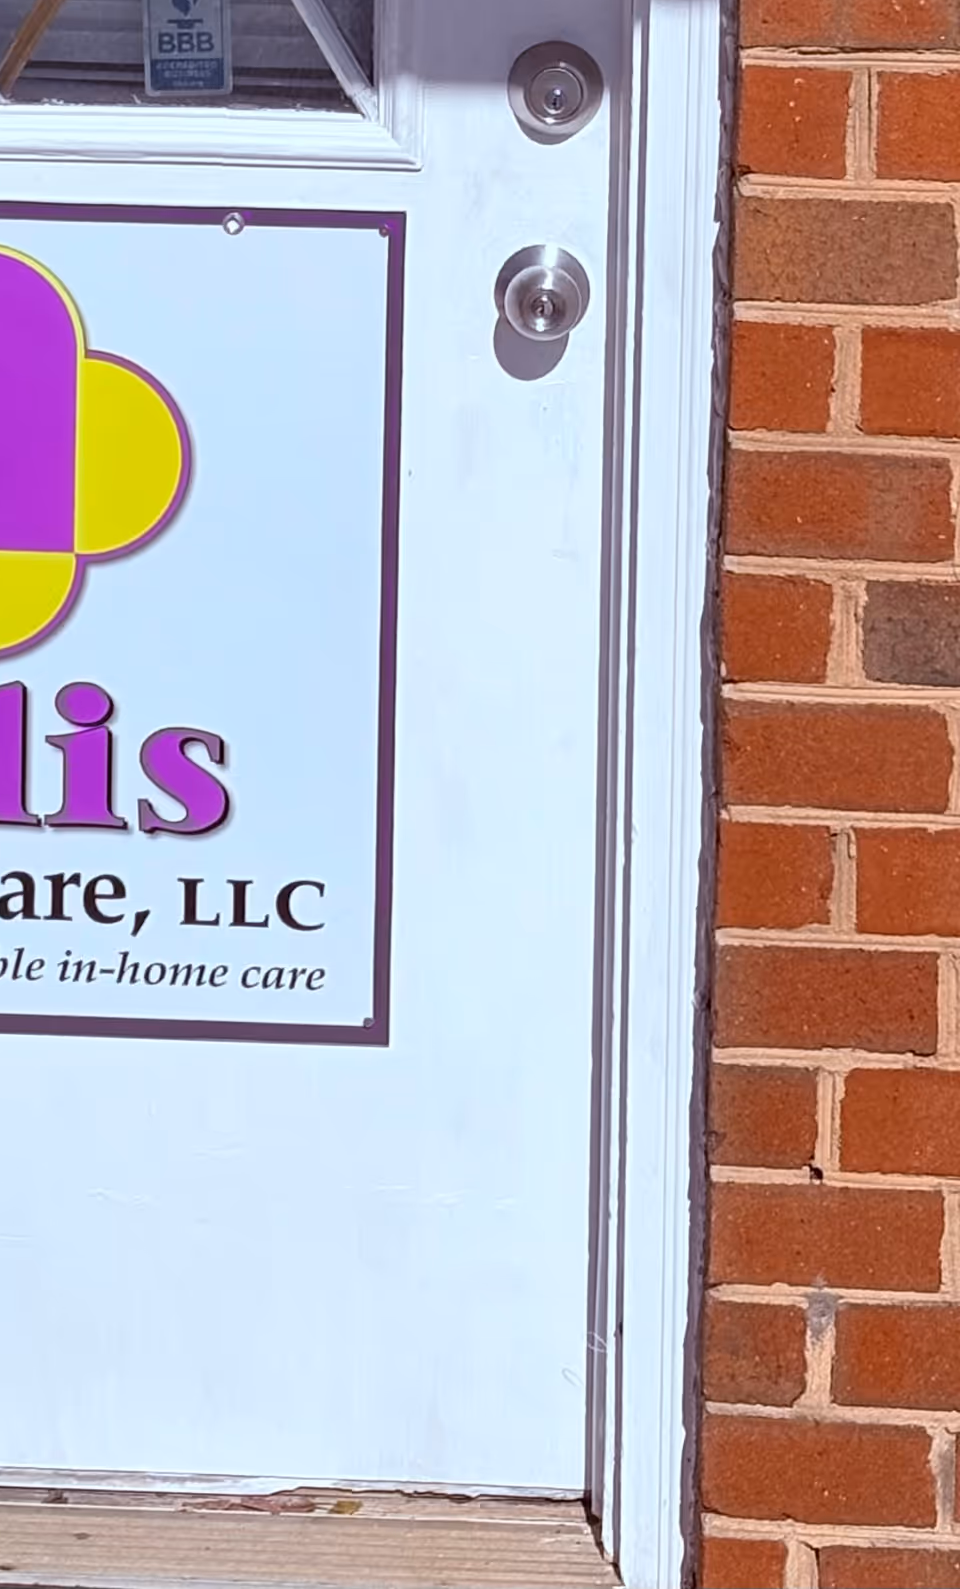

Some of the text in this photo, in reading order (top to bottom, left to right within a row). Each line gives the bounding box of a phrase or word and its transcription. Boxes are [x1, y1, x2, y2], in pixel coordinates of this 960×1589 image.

[158, 31, 214, 53] BBB
[177, 877, 326, 932] LLC
[57, 949, 229, 989] in-home
[241, 966, 326, 992] care
